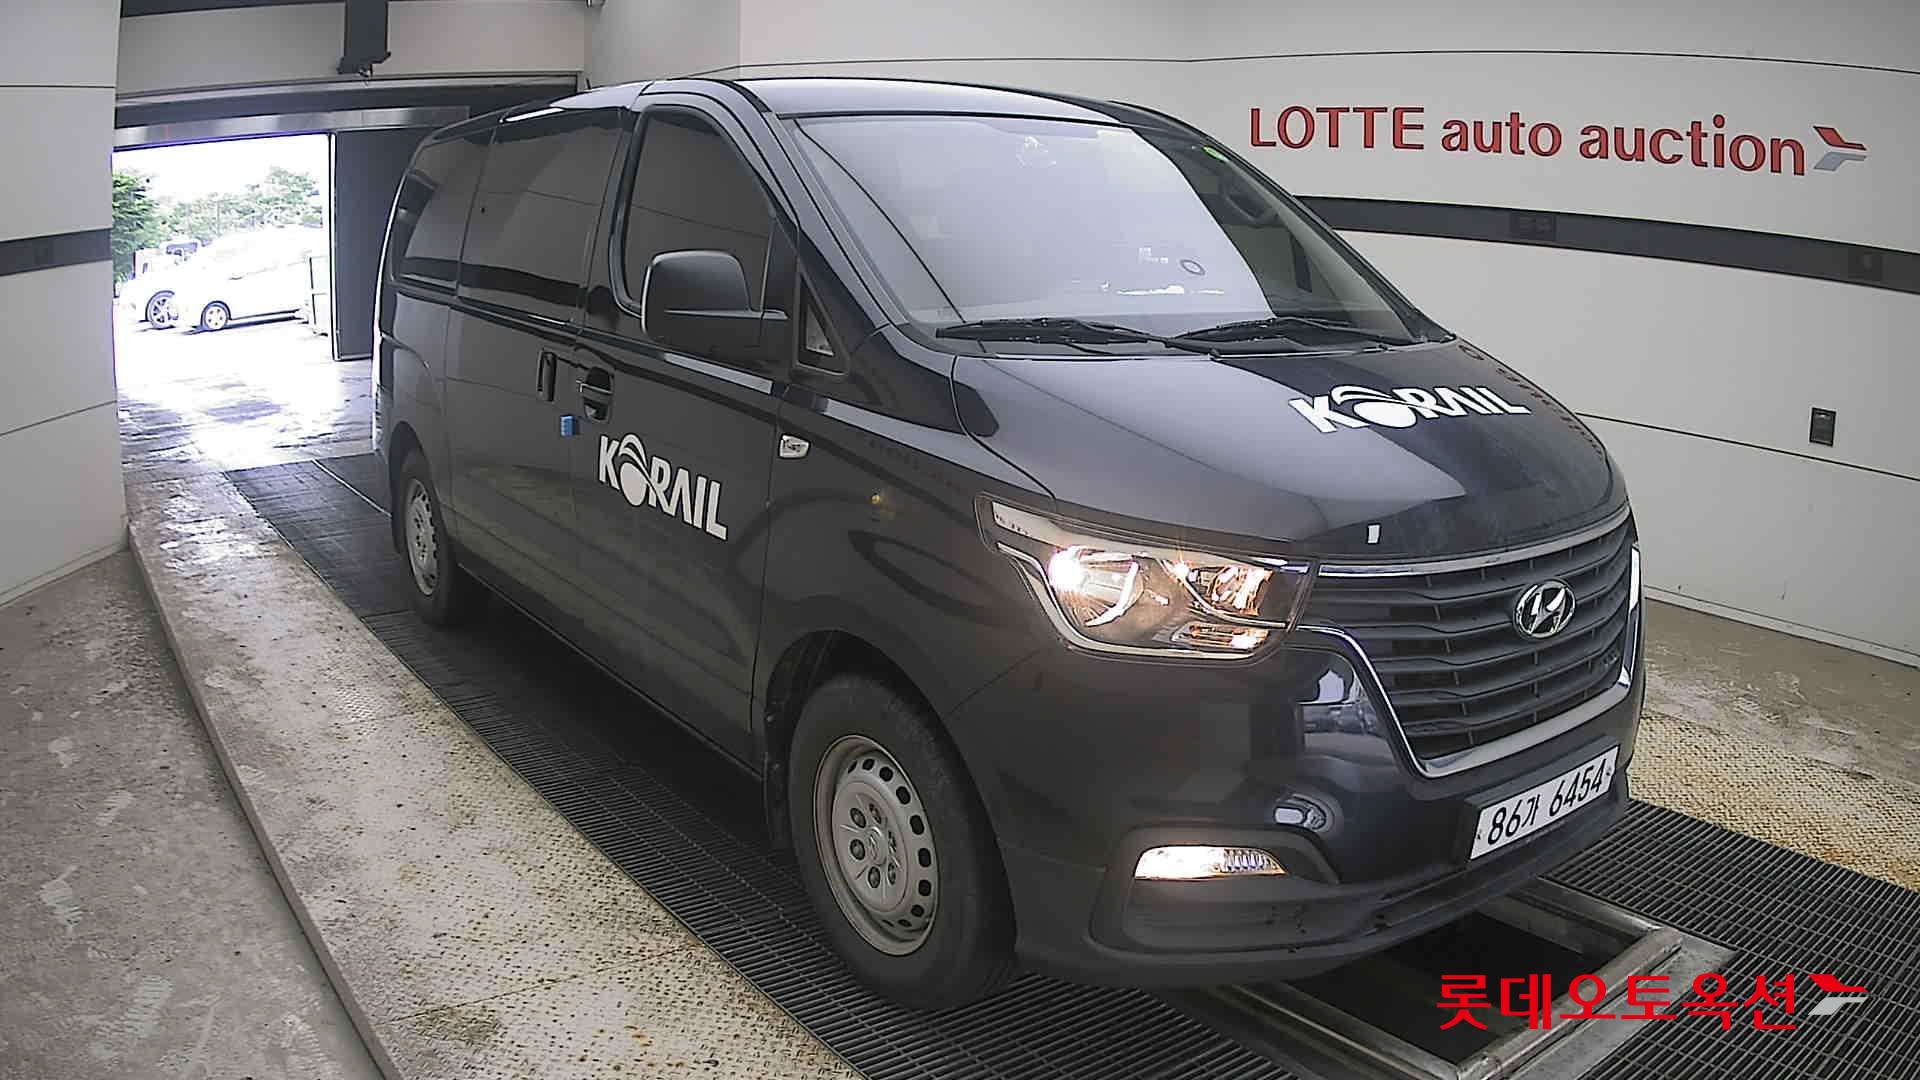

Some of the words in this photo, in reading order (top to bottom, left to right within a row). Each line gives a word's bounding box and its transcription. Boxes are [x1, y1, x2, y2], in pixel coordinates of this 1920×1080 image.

[1250, 106, 1425, 150] LOTTE
[1440, 112, 1562, 157] auto
[1579, 114, 1806, 176] auction
[1287, 384, 1532, 433] KORAIL
[599, 434, 728, 540] KORAIL
[1487, 793, 1541, 845] 86가
[1549, 758, 1607, 817] 6454
